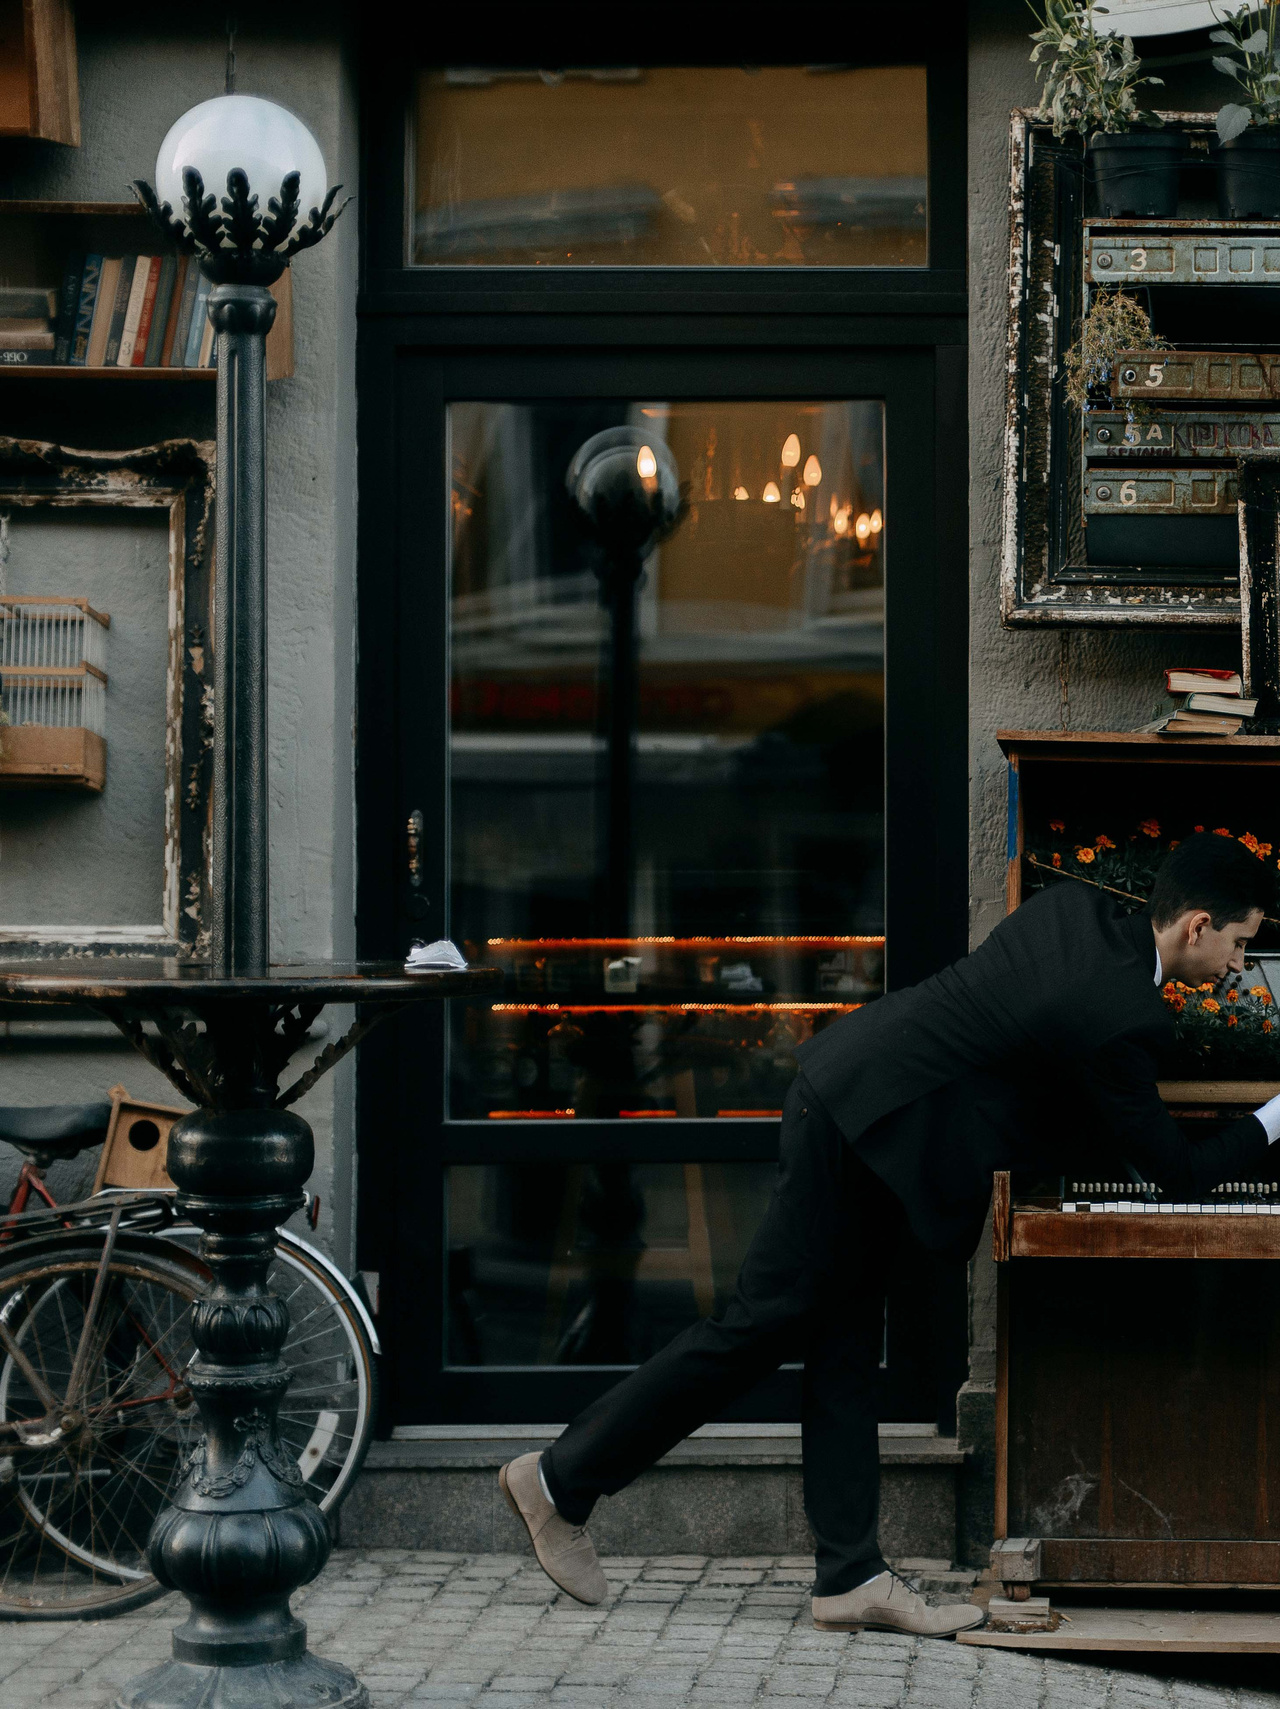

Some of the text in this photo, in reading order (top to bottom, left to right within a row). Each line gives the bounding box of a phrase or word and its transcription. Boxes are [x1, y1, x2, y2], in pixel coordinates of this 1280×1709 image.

[1130, 248, 1147, 271] 3
[1145, 364, 1164, 387] 5
[1120, 480, 1137, 505] 6
